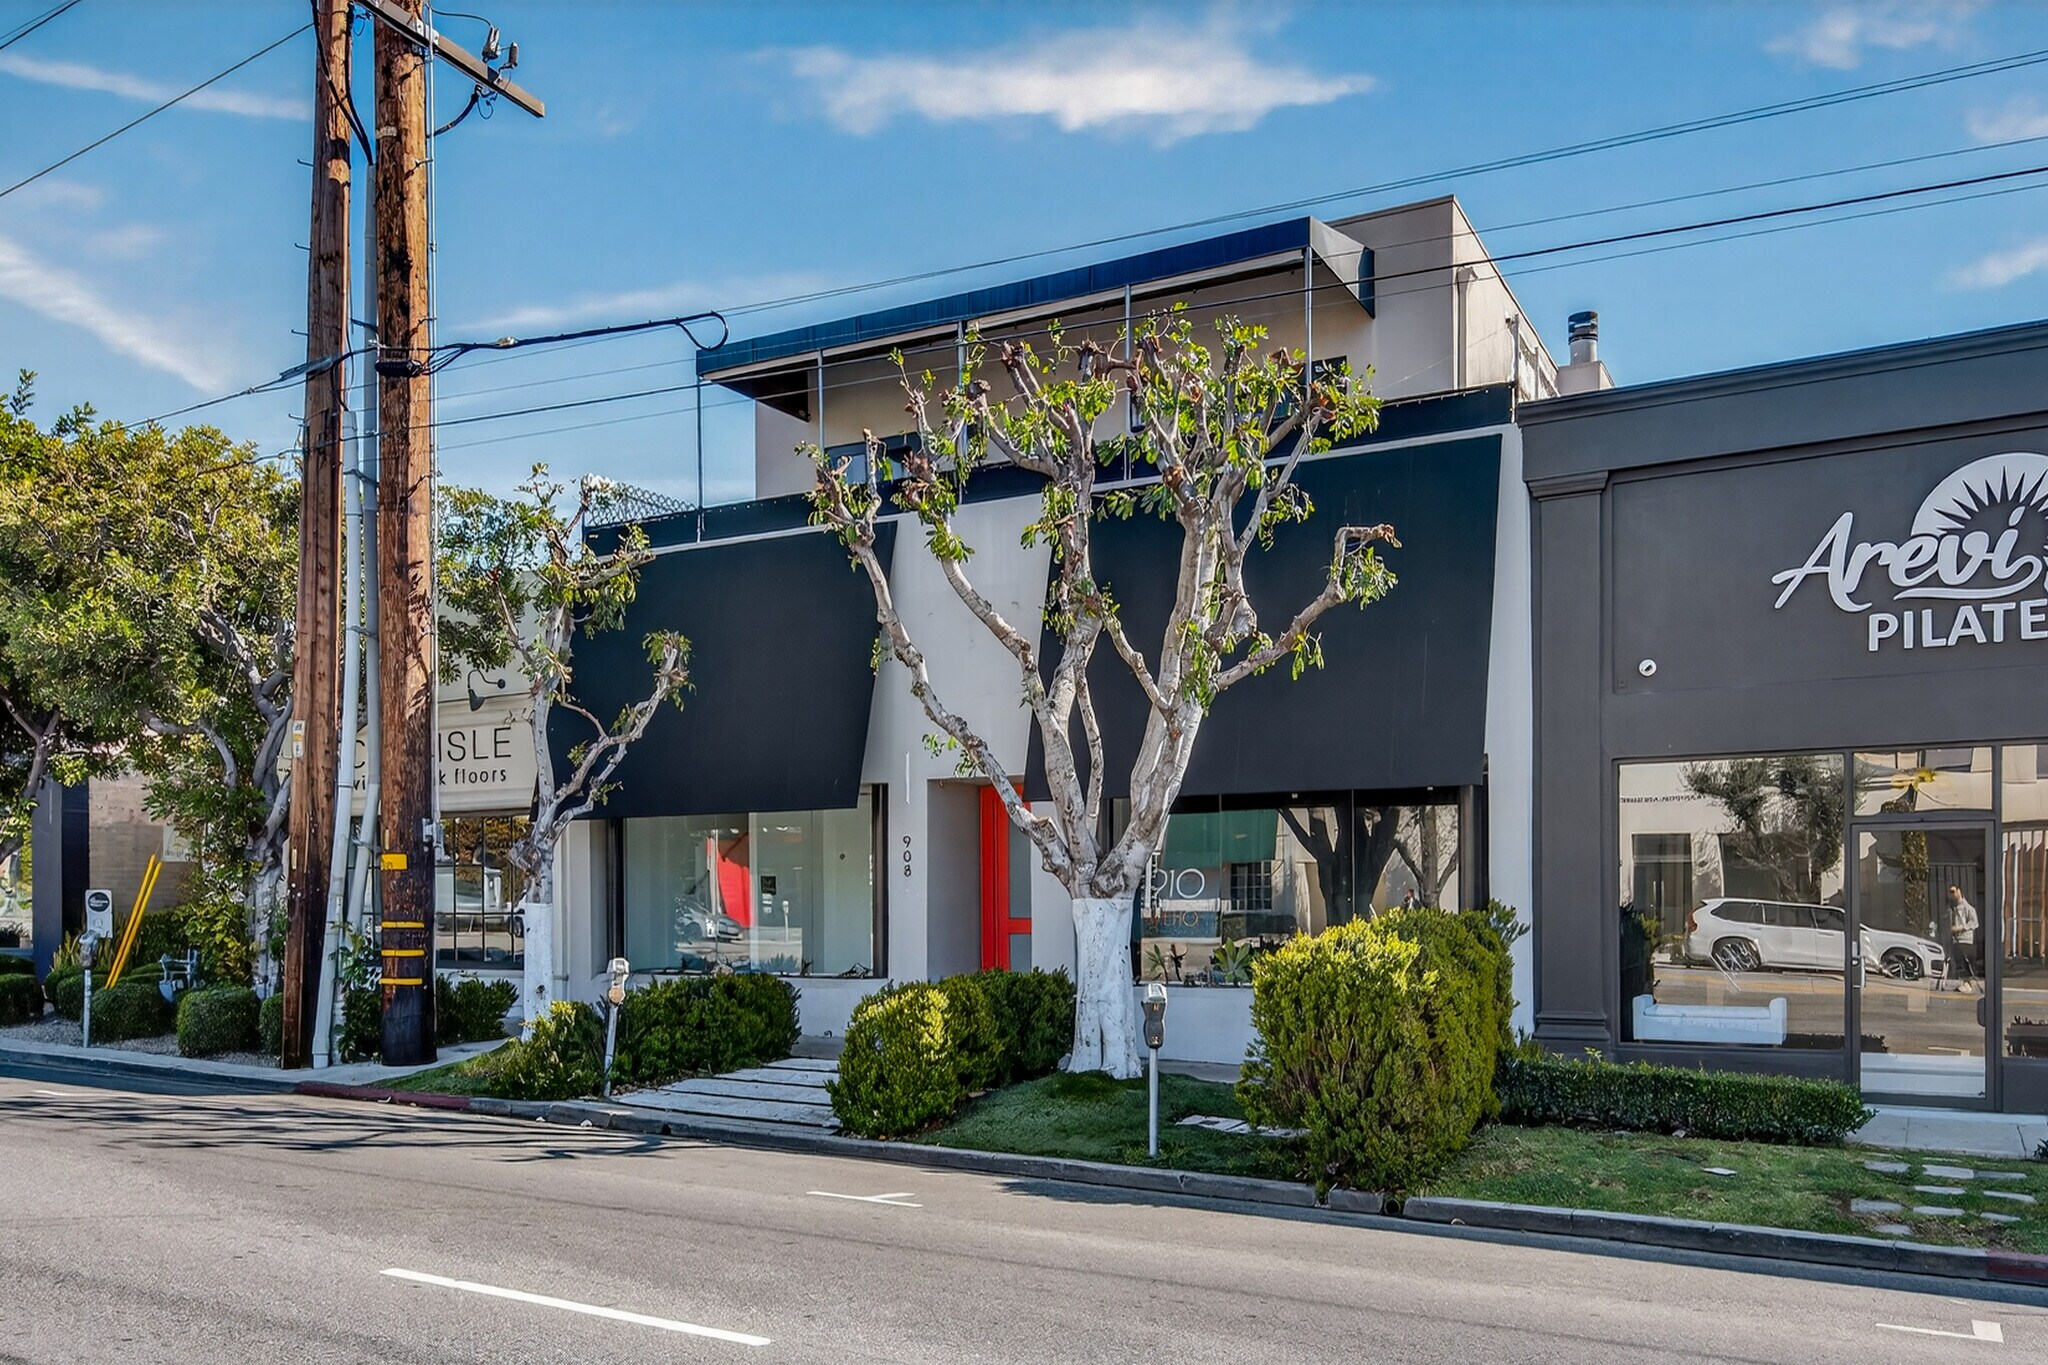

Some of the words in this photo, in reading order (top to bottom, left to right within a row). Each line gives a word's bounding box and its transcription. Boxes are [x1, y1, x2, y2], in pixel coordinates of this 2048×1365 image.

[1868, 598, 2048, 652] PILATE
[454, 768, 507, 784] floors
[903, 835, 912, 878] 908
